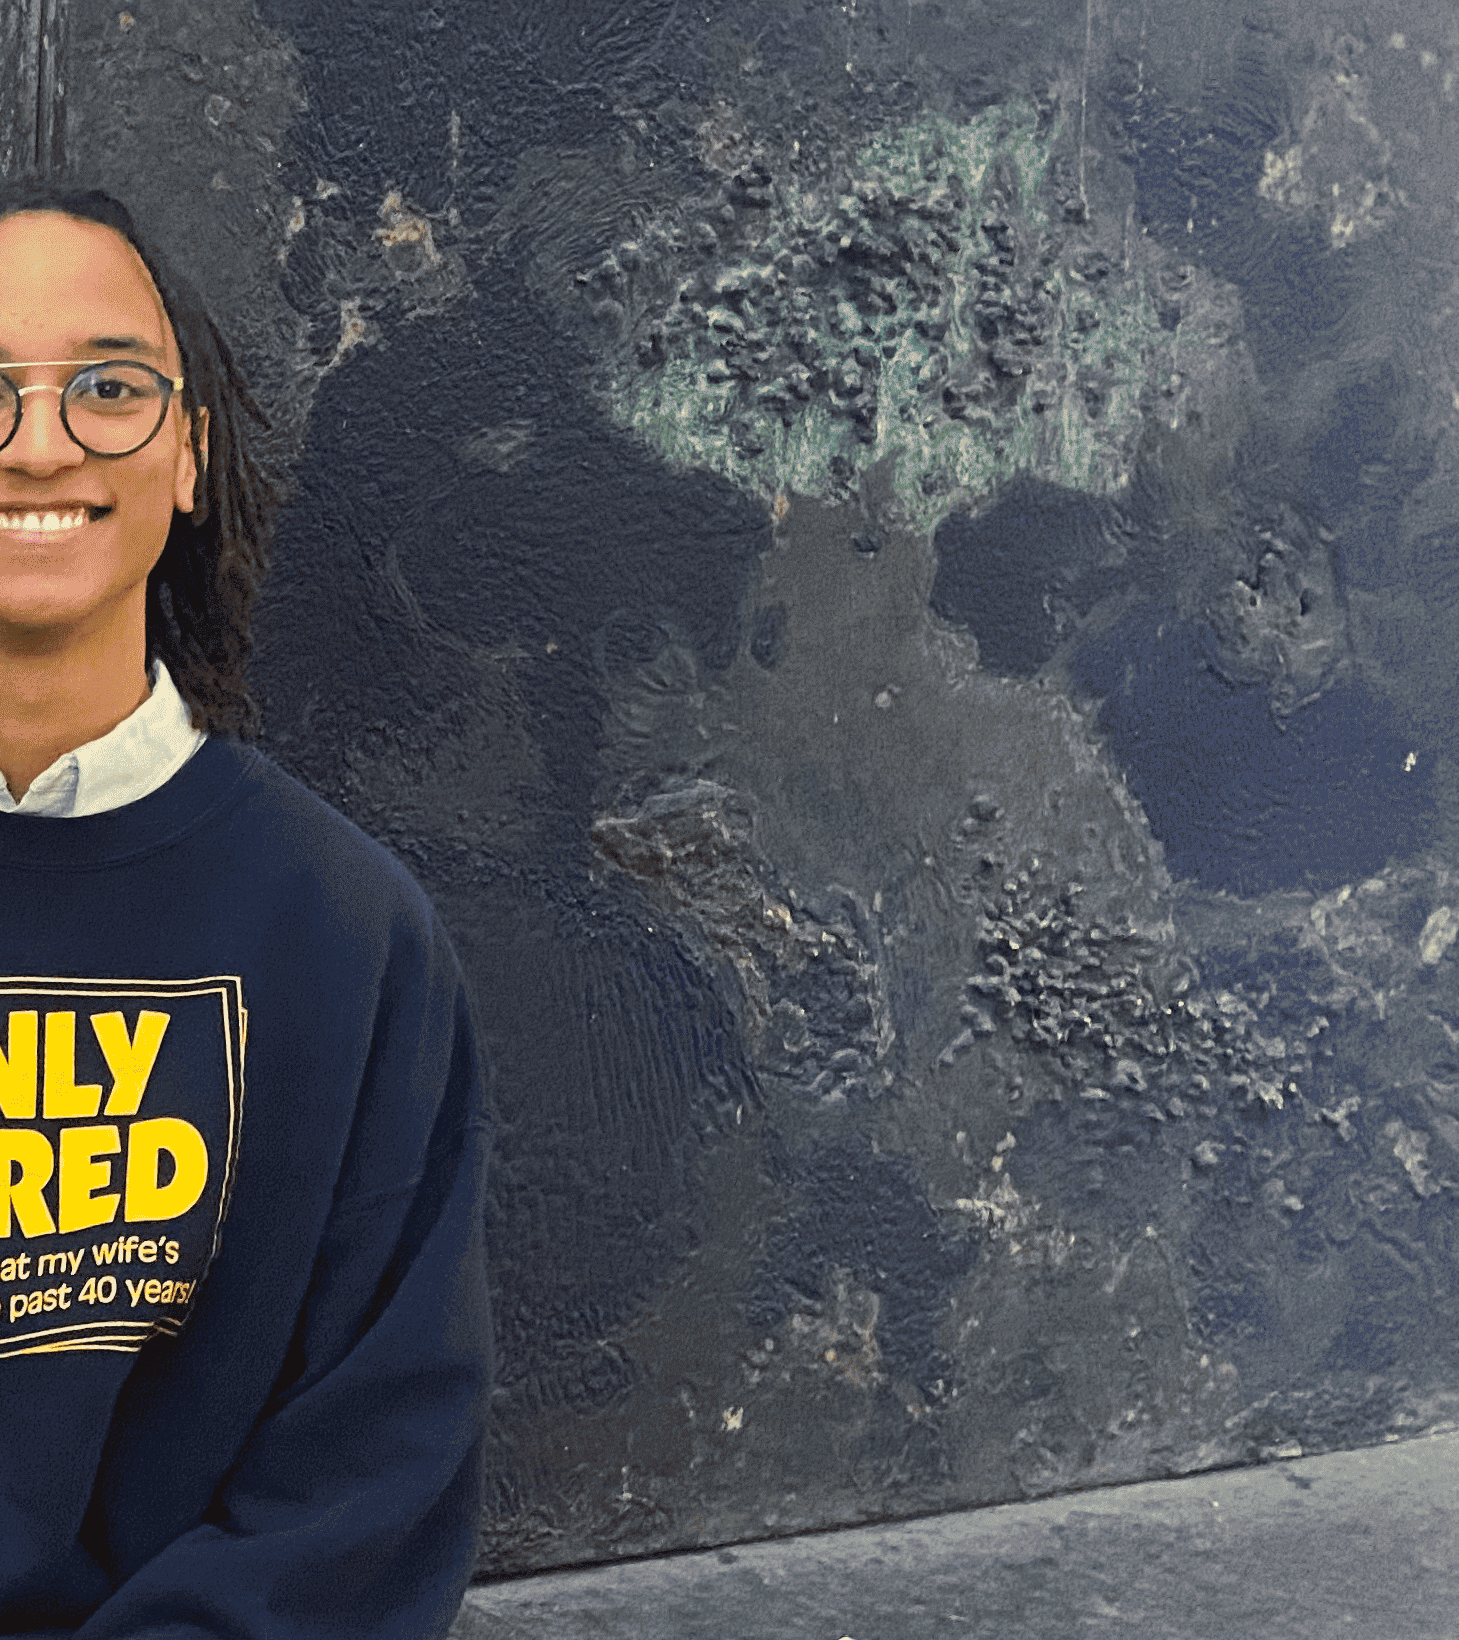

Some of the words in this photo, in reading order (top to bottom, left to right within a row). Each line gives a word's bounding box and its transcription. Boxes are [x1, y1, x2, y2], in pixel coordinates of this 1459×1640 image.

[37, 1248, 85, 1276] my
[92, 1235, 180, 1266] wife's
[9, 1282, 73, 1323] past
[78, 1275, 117, 1304] 40
[125, 1278, 197, 1308] years!
